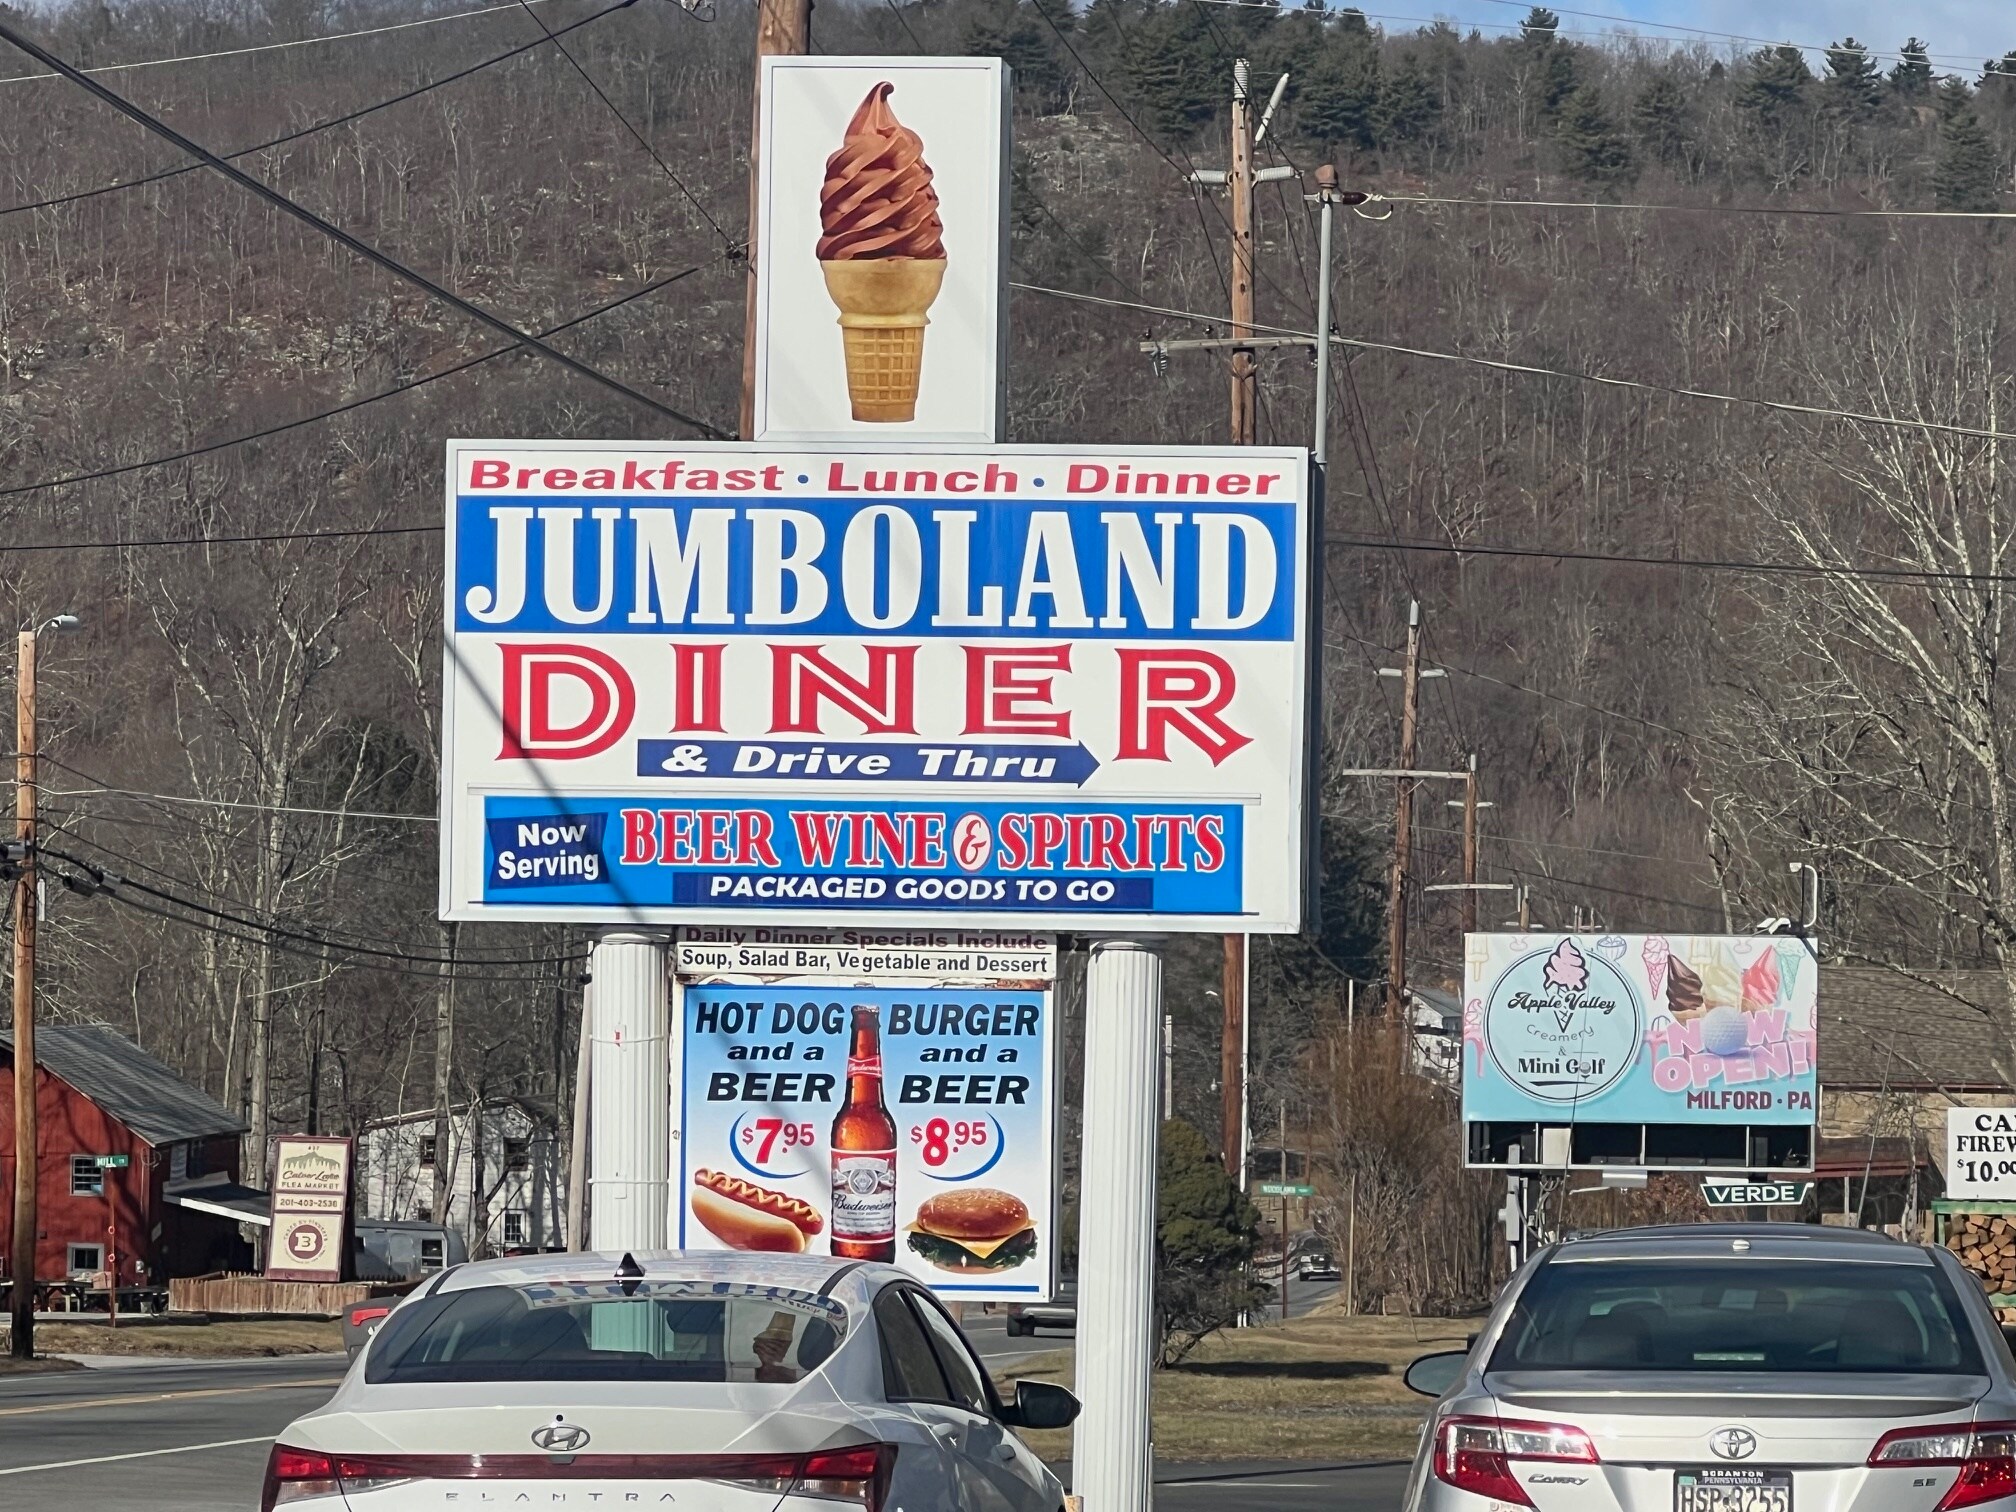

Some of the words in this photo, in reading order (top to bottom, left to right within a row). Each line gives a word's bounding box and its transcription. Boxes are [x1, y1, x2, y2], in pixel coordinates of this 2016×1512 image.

[470, 460, 784, 491] Breakfast
[827, 462, 1018, 493] Lunch
[1066, 464, 1281, 495] Dinner
[465, 505, 1277, 629] JUMBOLAND
[495, 642, 1254, 768] DINER
[661, 744, 708, 773] &
[733, 745, 890, 776] Drive
[918, 748, 1057, 779] Thru
[517, 822, 587, 848] Now
[619, 807, 782, 868] BEER
[788, 811, 947, 870] WINE
[958, 818, 987, 867] &
[997, 812, 1226, 873] SPIRITS
[498, 850, 600, 882] Serving
[710, 876, 887, 899] PACKAGED
[895, 878, 1007, 901] GOODS
[1015, 879, 1058, 901] TO
[1066, 880, 1115, 902] GO
[686, 927, 746, 946] Daily
[755, 929, 837, 945] Dinner
[843, 931, 949, 949] Specials
[958, 933, 1048, 950] Include
[682, 949, 732, 969] Soup,
[738, 949, 789, 967] Salad
[795, 951, 831, 971] Bar,
[837, 951, 931, 972] Vegetable
[937, 955, 969, 971] and
[977, 955, 1047, 973] Dessert
[1507, 991, 1561, 1013] Apple
[1564, 993, 1616, 1015] Valley
[696, 1002, 764, 1034] HOT
[771, 1002, 845, 1035] DOG
[888, 1002, 1040, 1036] BURGER
[1526, 1024, 1595, 1042] Creamery
[727, 1041, 794, 1061] and
[803, 1046, 825, 1061] a
[920, 1044, 988, 1063] and
[997, 1048, 1018, 1063] a
[1518, 1058, 1560, 1074] Mini
[1653, 1039, 1810, 1093] OPEN!
[707, 1072, 836, 1102] BEER
[900, 1074, 1031, 1104] BEER
[1687, 1090, 1772, 1110] MILFORD
[1787, 1091, 1812, 1110] PA
[1975, 1114, 2016, 1132] CA
[1711, 1186, 1795, 1203] VERDE
[445, 1492, 676, 1502] ELANTRA
